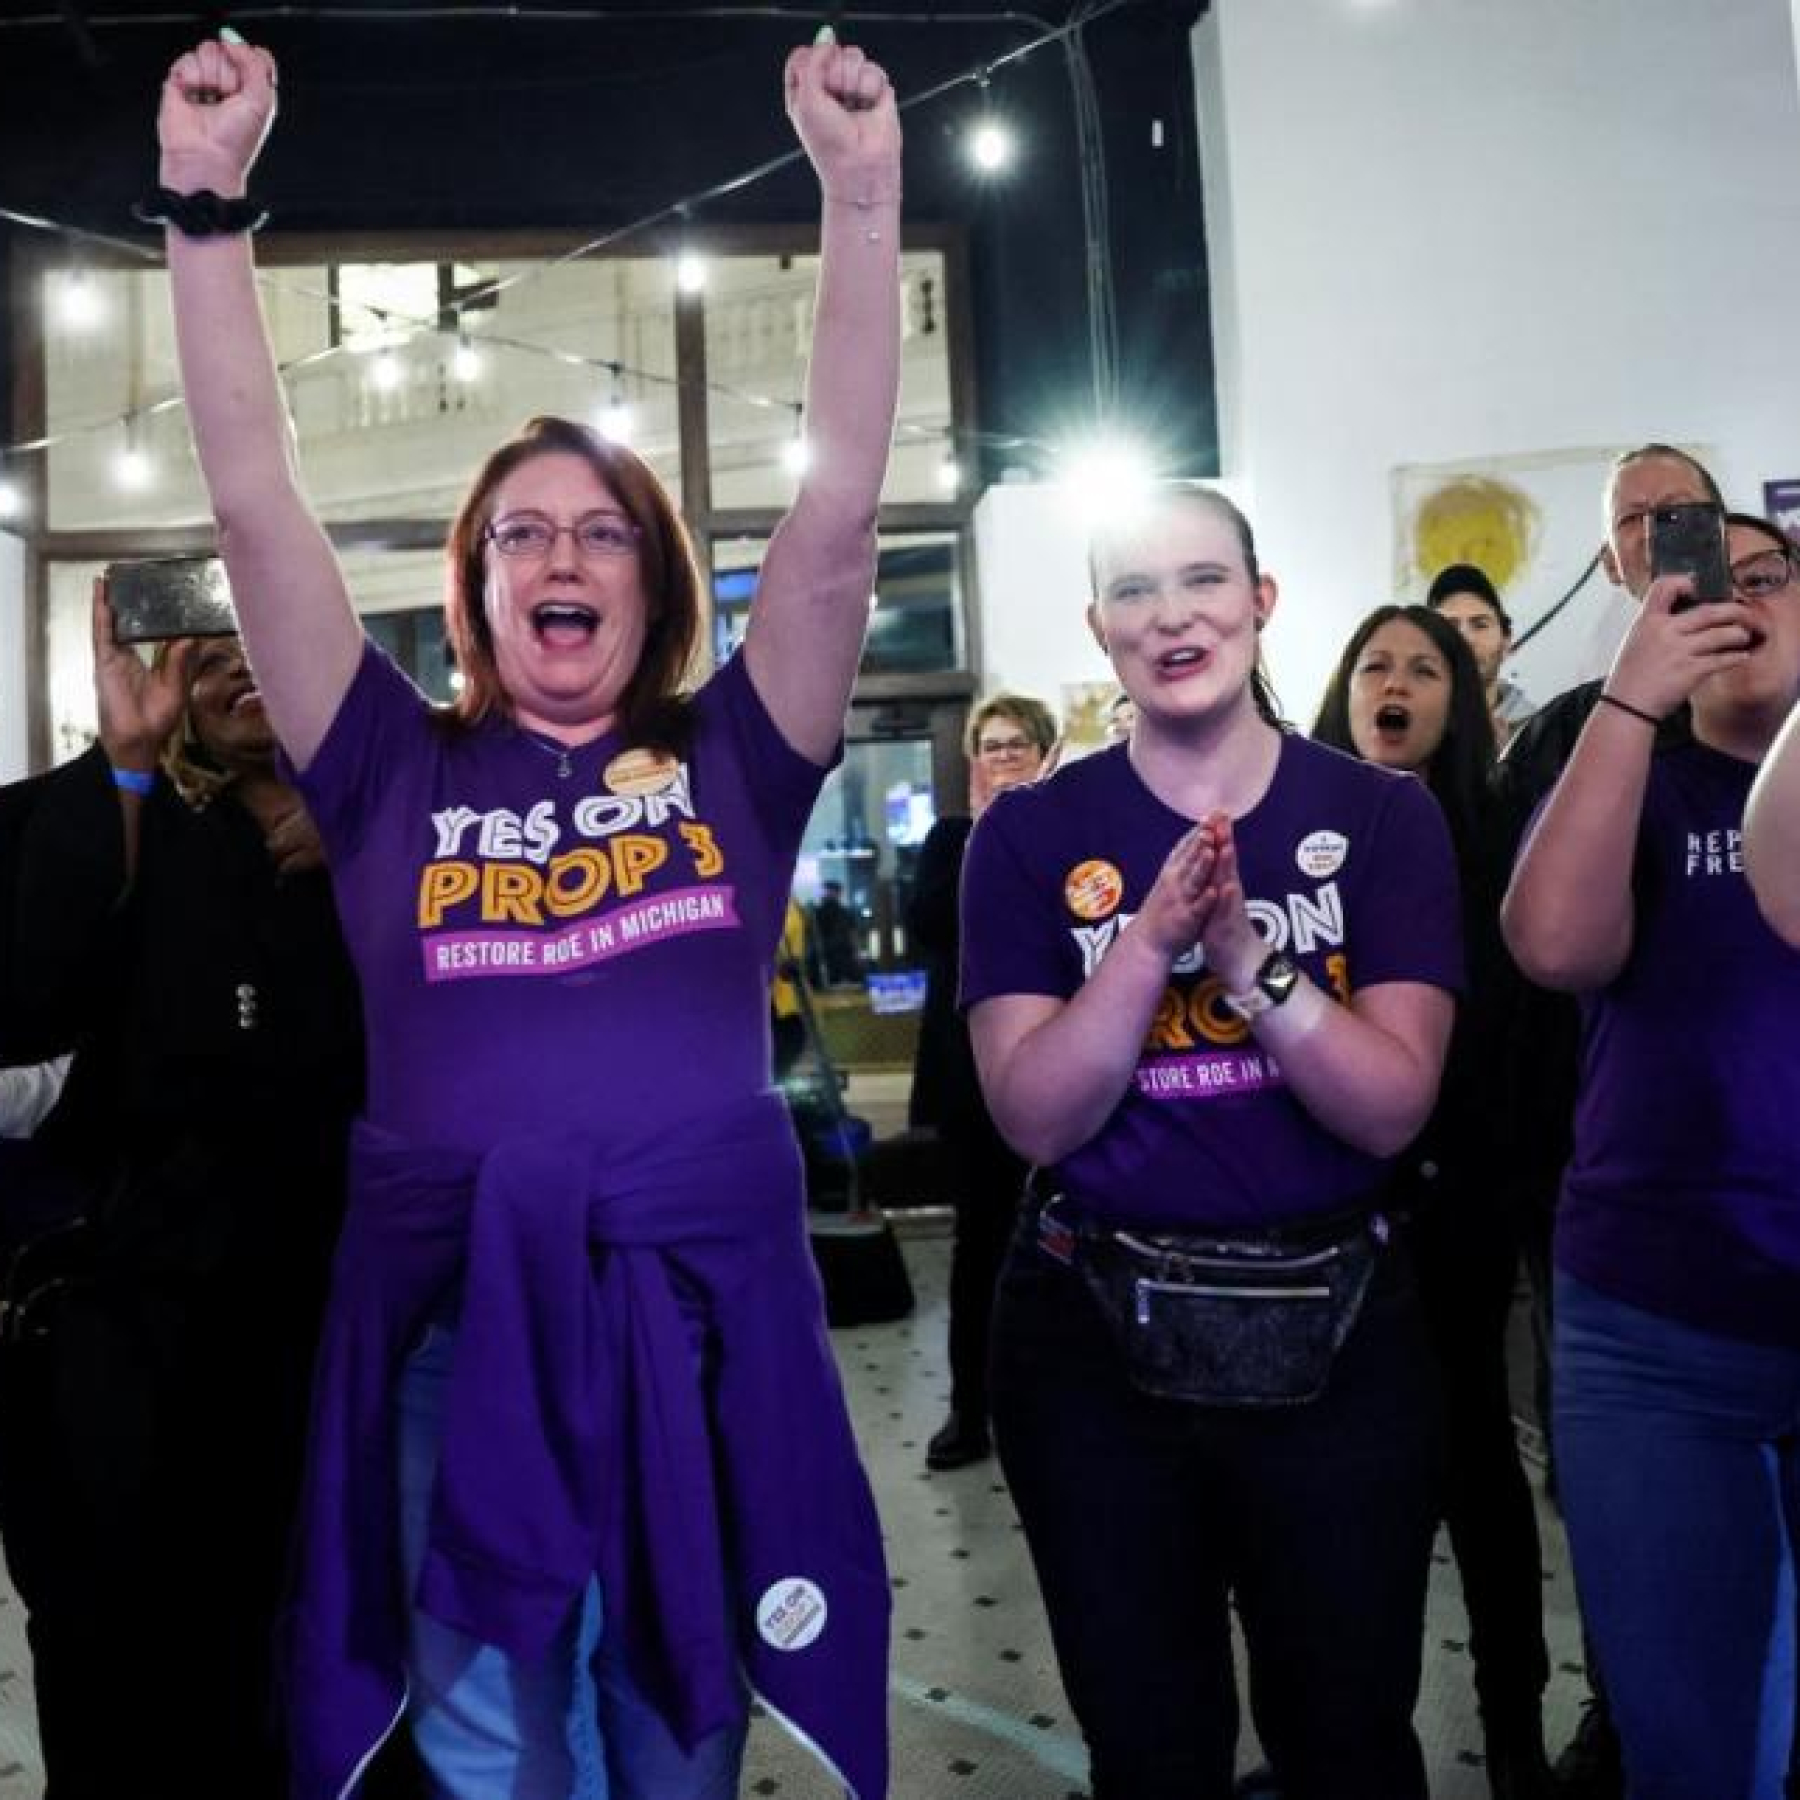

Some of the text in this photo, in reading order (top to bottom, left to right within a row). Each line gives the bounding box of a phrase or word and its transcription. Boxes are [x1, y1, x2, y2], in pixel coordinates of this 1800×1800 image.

[431, 762, 696, 865] YES ON
[418, 819, 724, 929] PROP 3
[437, 893, 725, 971] RESTORE ROE IN MICHIGAN
[1196, 1061, 1236, 1089] ROE
